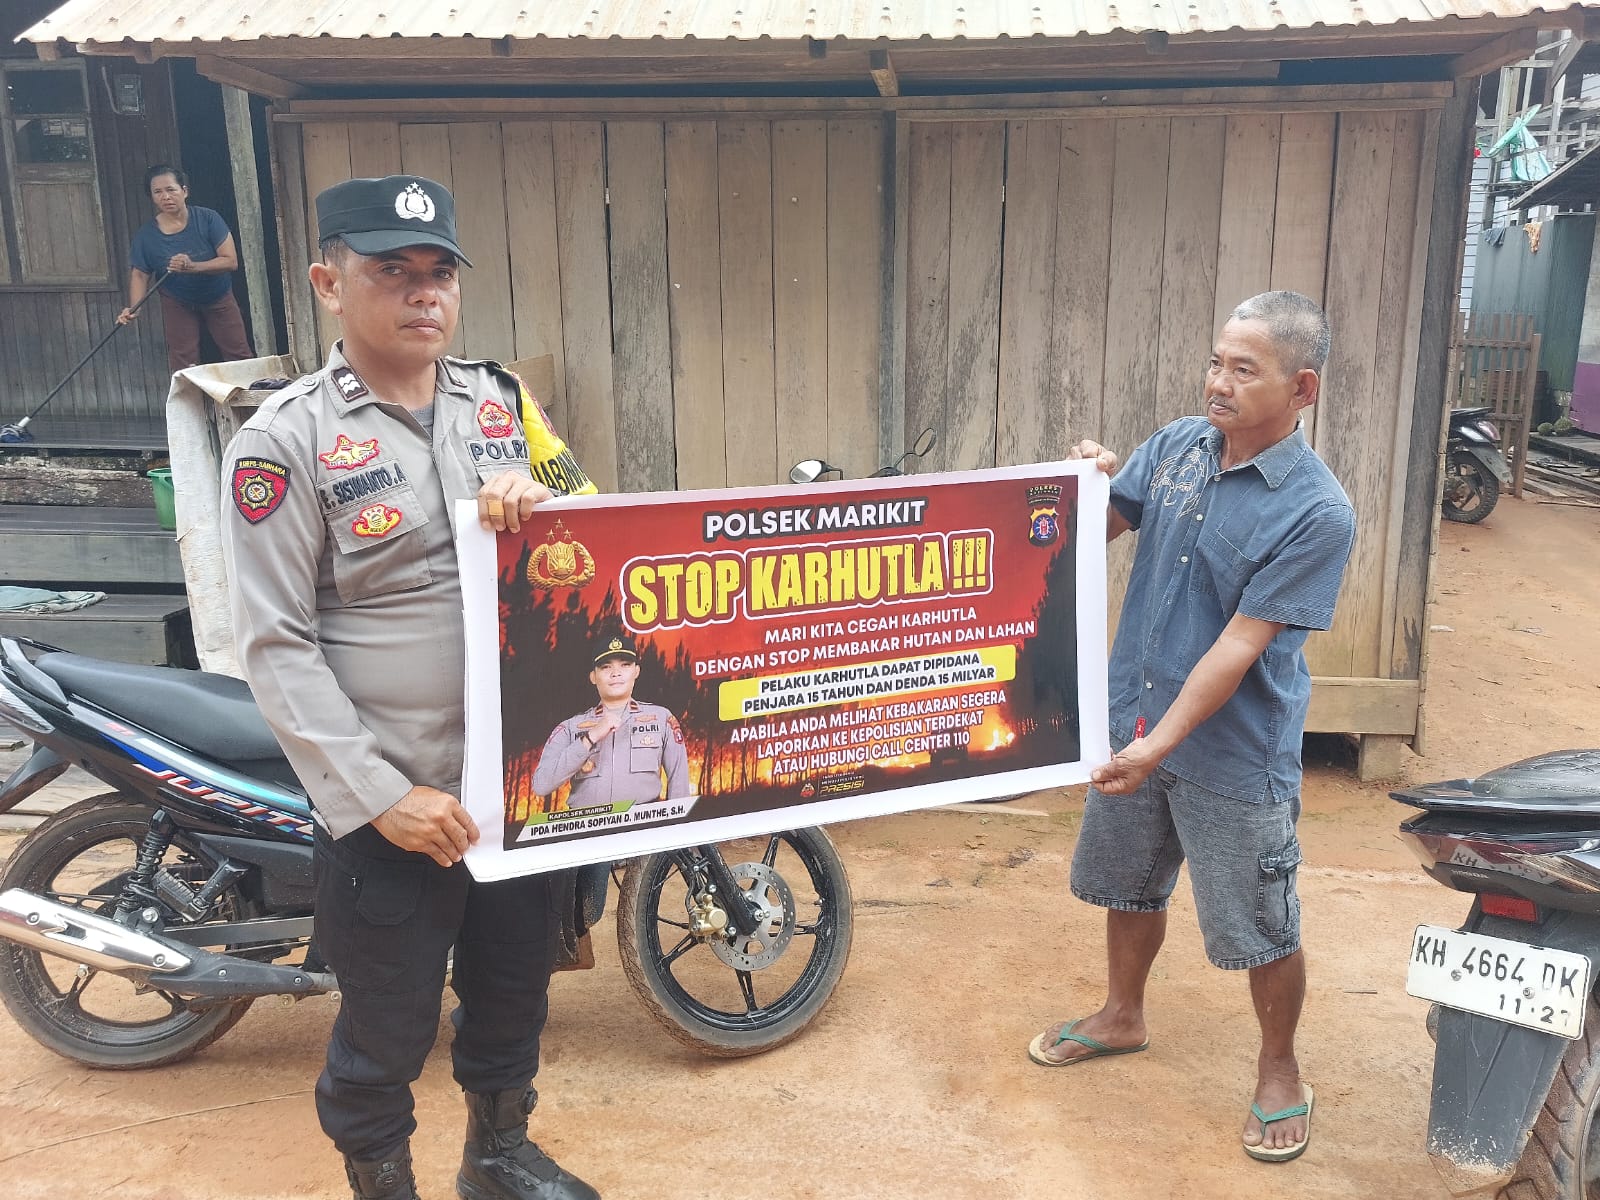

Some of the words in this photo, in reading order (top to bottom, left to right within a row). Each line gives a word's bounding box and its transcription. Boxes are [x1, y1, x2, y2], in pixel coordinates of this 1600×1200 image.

[470, 440, 529, 461] POLRI
[706, 506, 811, 539] POLSEK
[815, 500, 926, 530] MARIKIT
[628, 559, 741, 626] STOP
[750, 541, 945, 611] KARHUTLA
[765, 625, 806, 644] MARI
[810, 621, 845, 639] KITA
[847, 615, 899, 635] CEGAH
[901, 606, 977, 628] KARHUTLA
[695, 653, 765, 676] DENGAN
[769, 648, 810, 666] STOP
[813, 637, 900, 661] MEMBAKAR
[903, 630, 952, 649] HUTAN
[955, 626, 985, 643] DAN
[988, 620, 1035, 639] LAHAN
[744, 694, 805, 713] PENJARA
[807, 691, 820, 703] 15
[821, 685, 864, 701] TAHUN
[866, 680, 894, 694] DAN
[895, 675, 936, 691] DENDA
[938, 673, 950, 684] 15
[951, 667, 995, 683] MILYAR
[761, 674, 811, 694] PELAKU
[813, 664, 880, 685] KARHUTLA
[881, 660, 921, 677] DAPAT
[923, 653, 980, 671] DIPIDANA
[632, 724, 659, 735] POLRI
[730, 721, 788, 744] APABILA
[790, 715, 827, 734] ANDA
[829, 706, 884, 728] MELIHAT
[885, 696, 959, 719] KEBAKARAN
[961, 689, 1006, 706] SEGERA
[757, 734, 830, 759] LAPORKAN
[832, 732, 848, 747] KE
[850, 719, 922, 744] KEPOLISIAN
[924, 710, 984, 732] TERDEKAT
[773, 755, 808, 775] ATAU
[811, 746, 869, 769] HUBUNGI
[871, 742, 903, 759] CALL
[904, 733, 950, 751] CENTER
[953, 731, 970, 746] 110
[132, 764, 314, 836] JUPIT
[530, 825, 550, 837] IPDA
[552, 820, 586, 834] HENDRA
[587, 814, 622, 829] SOPIYAN
[624, 813, 632, 823] D.
[633, 808, 669, 822] MUNTHE,
[670, 805, 686, 816] S.H.
[548, 809, 584, 821] KAPOLSEK
[584, 805, 613, 816] MARIKIT
[1415, 934, 1447, 968] KH
[1461, 946, 1526, 984] 4664
[1542, 961, 1579, 999] DK
